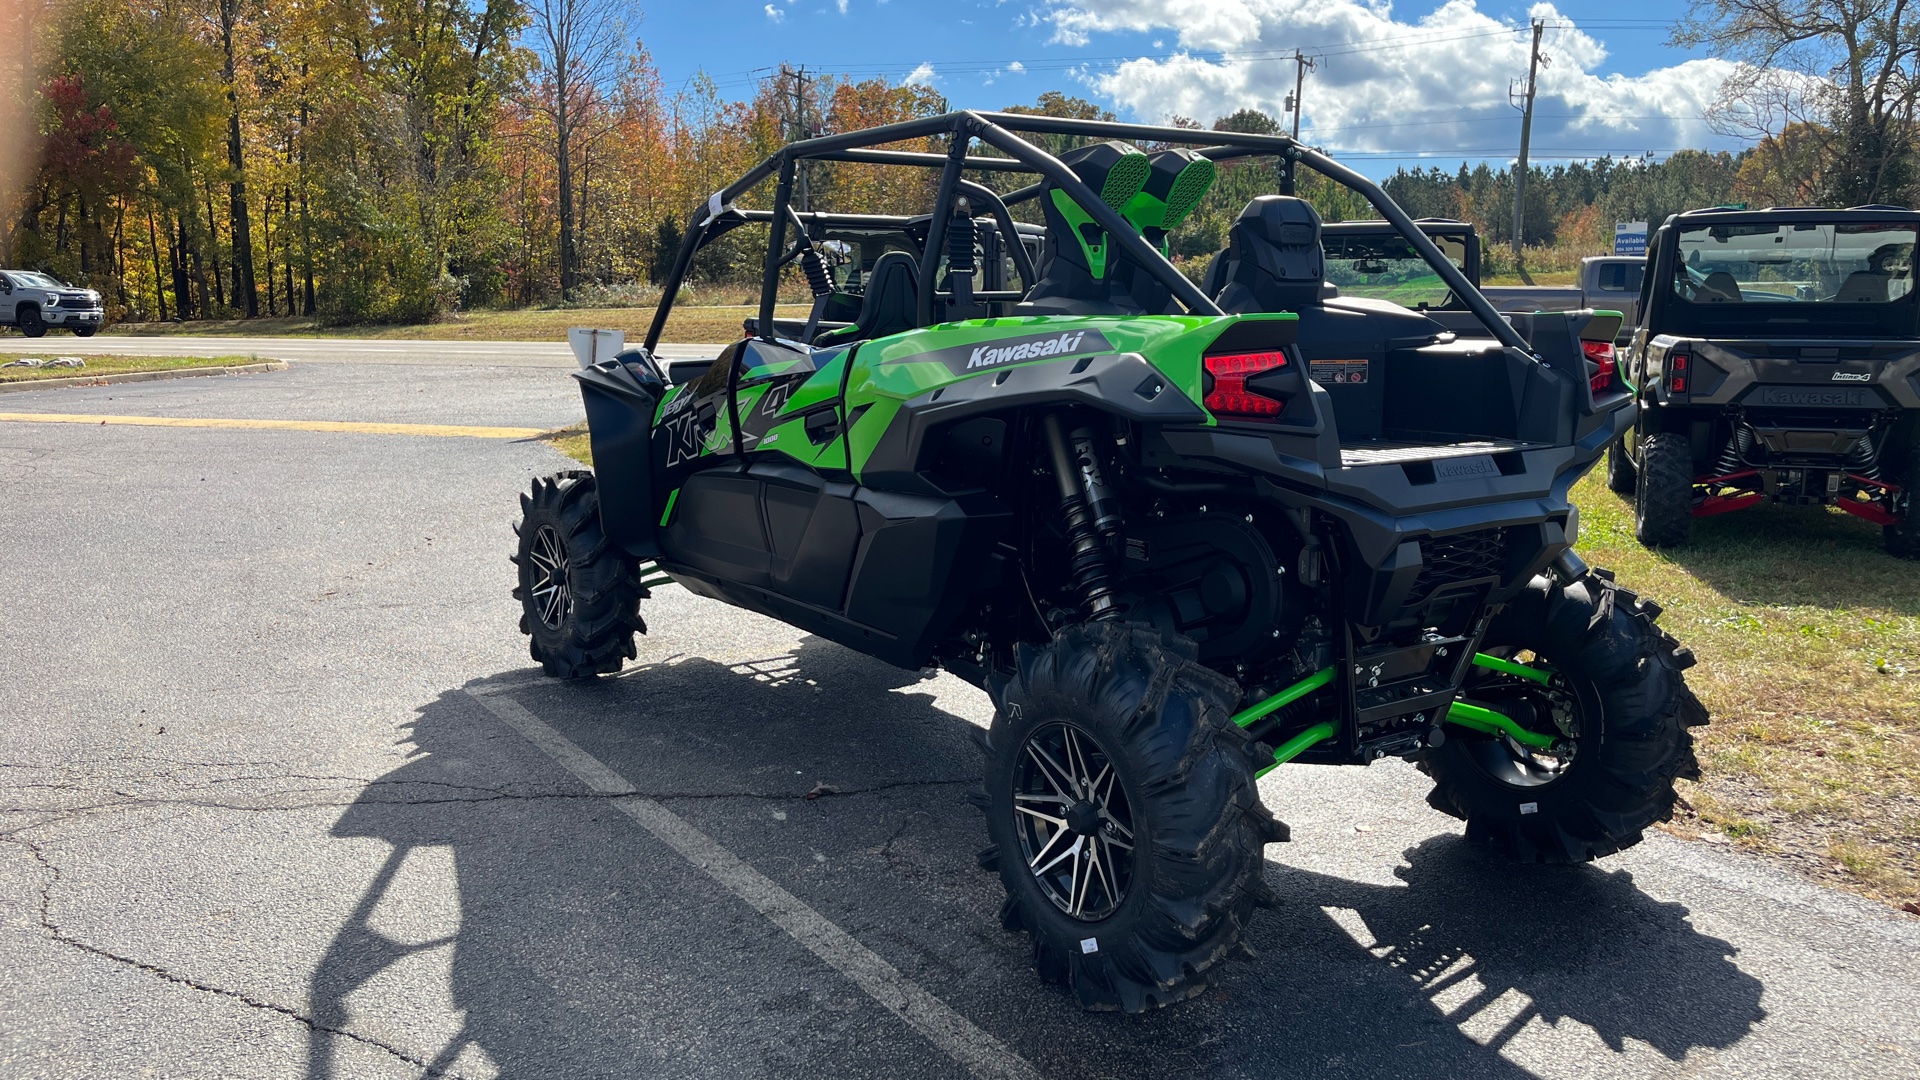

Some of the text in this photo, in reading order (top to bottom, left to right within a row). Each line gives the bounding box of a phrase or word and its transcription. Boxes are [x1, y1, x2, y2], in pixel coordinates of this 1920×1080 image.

[967, 332, 1085, 369] Kawasaki
[762, 383, 789, 419] 4
[1763, 389, 1867, 405] Kawasaki
[763, 434, 778, 445] 1000
[1074, 440, 1103, 492] FOX
[1438, 460, 1494, 477] Kawasaki
